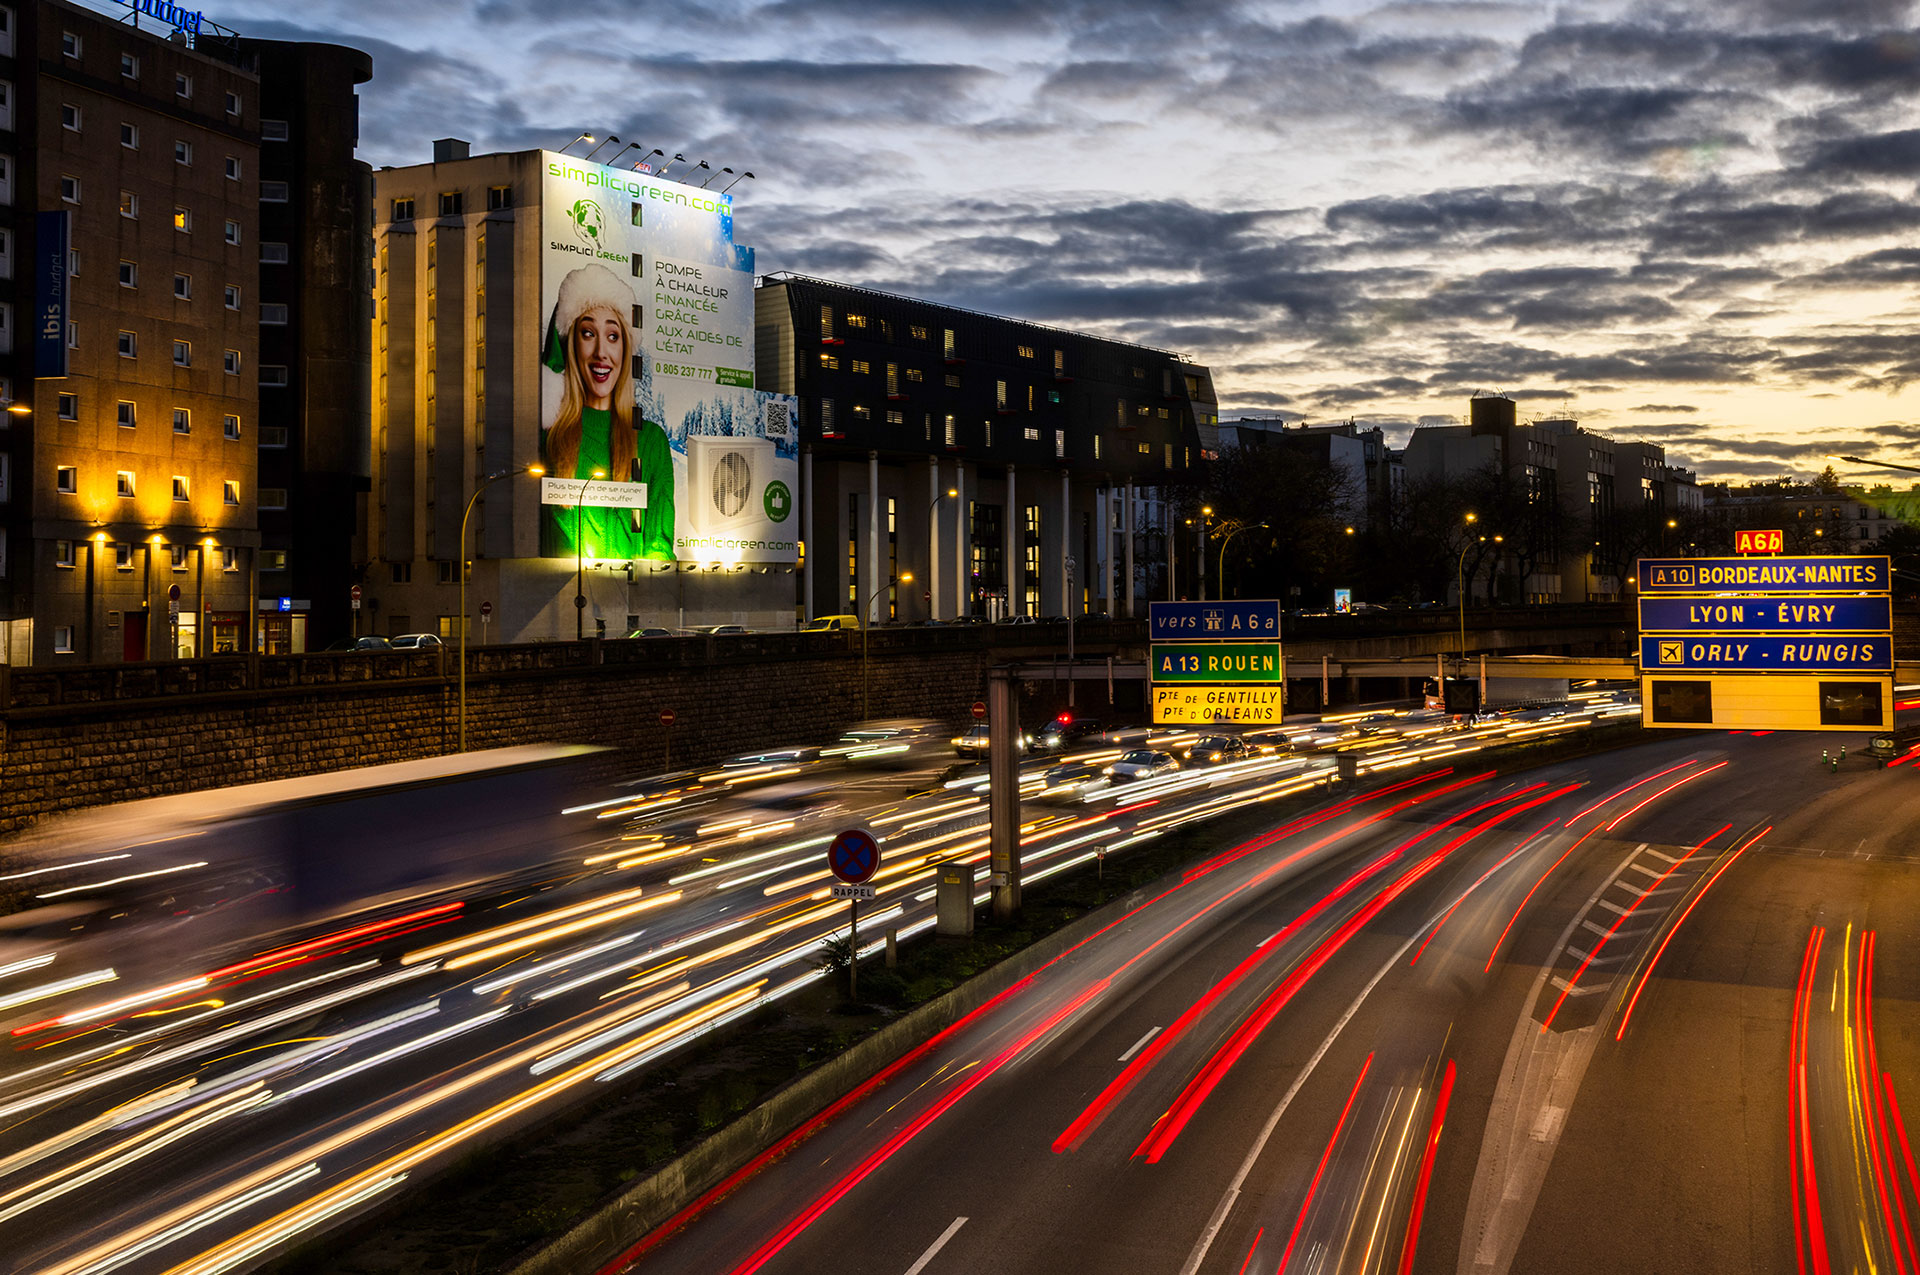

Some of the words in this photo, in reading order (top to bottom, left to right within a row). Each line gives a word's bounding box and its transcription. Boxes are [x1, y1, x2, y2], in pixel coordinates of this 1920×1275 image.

[549, 163, 731, 216] simplicigreen.com
[550, 241, 594, 257] SIMPLICI
[596, 250, 629, 264] GREEN
[50, 254, 64, 296] budget
[655, 261, 703, 280] POMPE
[655, 274, 666, 289] À
[668, 279, 729, 300] CHALEUR
[655, 293, 719, 313] FINANCÉE
[43, 303, 60, 339] ibis
[655, 309, 699, 326] GRÂCE
[655, 325, 684, 339] AUX
[686, 329, 724, 345] AIDES
[726, 335, 743, 348] DE
[655, 338, 695, 356] L'ÉTAT
[655, 362, 661, 373] 0
[663, 363, 679, 376] 805
[680, 365, 696, 378] 237
[697, 368, 713, 380] 777
[547, 481, 566, 490] Plus
[547, 492, 567, 500] pour
[600, 494, 633, 503] chauffer
[676, 536, 794, 551] simplicigreen.com
[1739, 533, 1780, 551] A6b
[1670, 569, 1689, 583] 10
[1699, 565, 1877, 585] BORDEAUX-NANTES
[1690, 605, 1744, 623] LYON
[1778, 602, 1836, 623] ÉVRY
[1158, 616, 1197, 628] vers
[1691, 644, 1749, 661] ORLY
[1782, 644, 1874, 662] RUNGIS
[1208, 655, 1273, 672] ROUEN
[1185, 695, 1198, 704] DE
[1206, 691, 1278, 704] GENTILLY
[833, 887, 873, 898] RAPPEL
